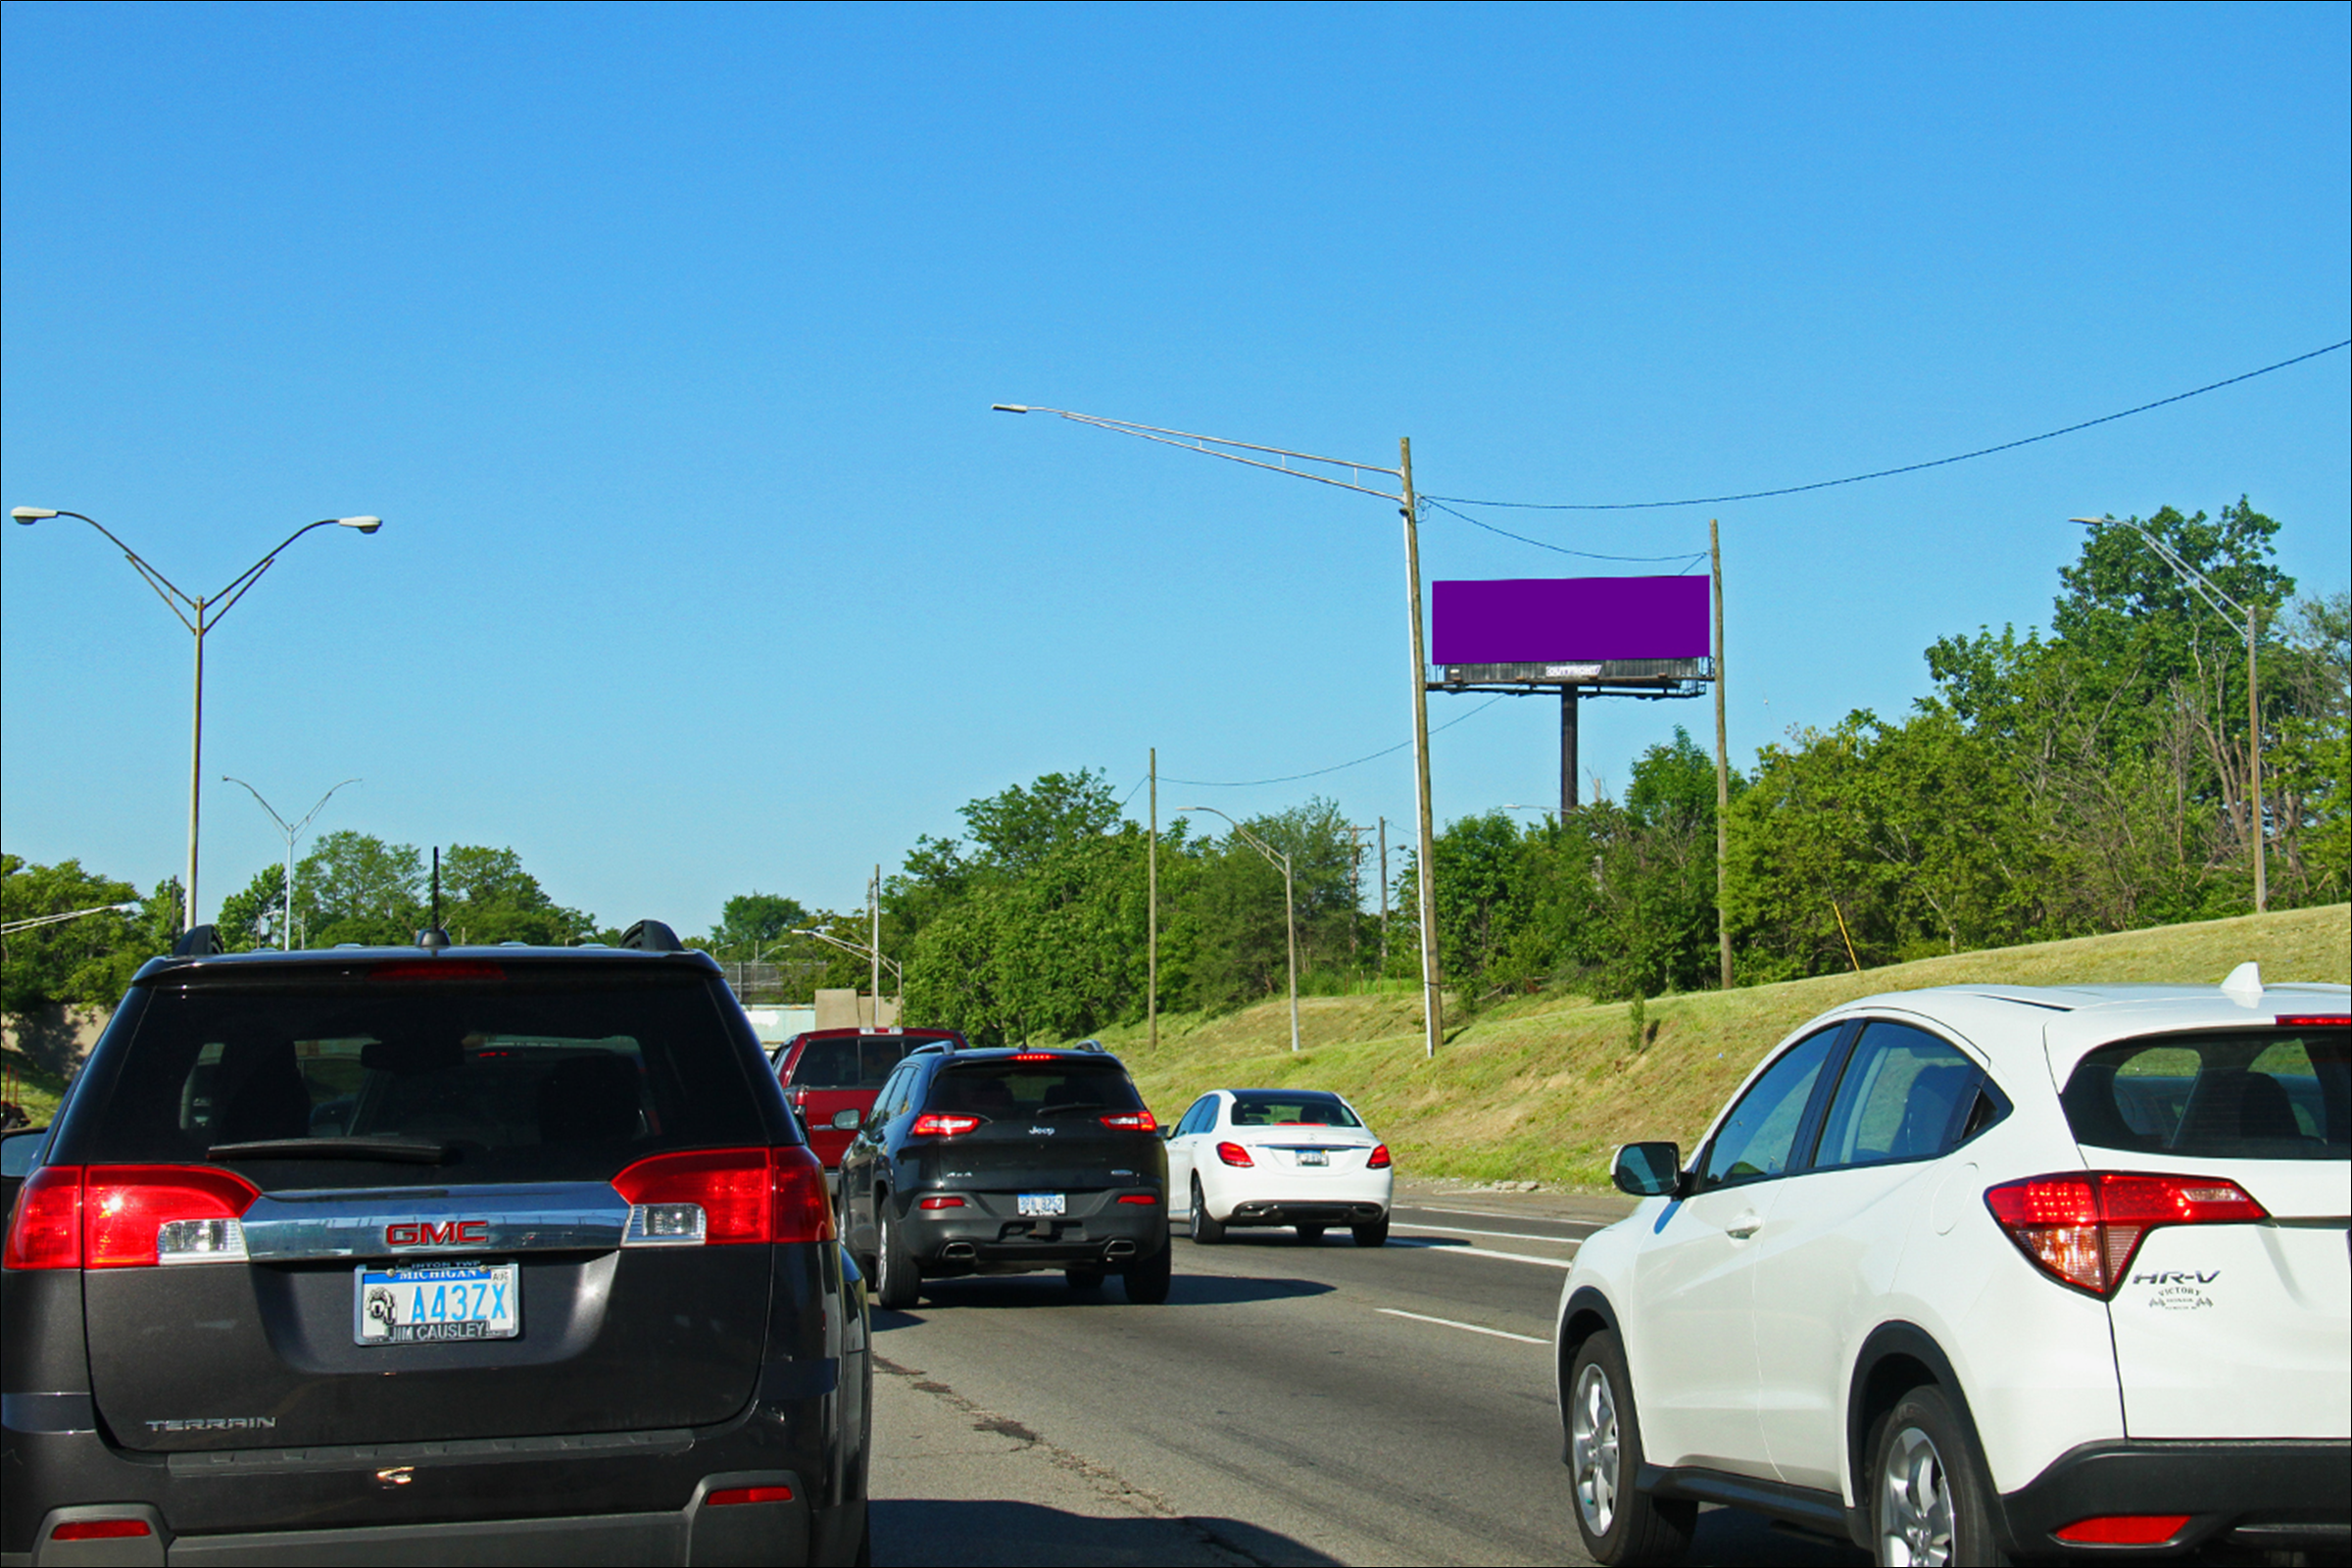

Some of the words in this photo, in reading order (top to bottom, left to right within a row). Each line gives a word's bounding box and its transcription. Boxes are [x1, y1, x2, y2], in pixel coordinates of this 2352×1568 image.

[1029, 1126, 1055, 1136] Jeep
[386, 1220, 488, 1246] GMC
[400, 1269, 477, 1280] MICHIGAN
[2132, 1270, 2221, 1285] HR-V
[2158, 1286, 2201, 1297] VICTORY
[411, 1283, 508, 1324] A43ZX
[389, 1324, 414, 1342] JIM
[416, 1321, 485, 1341] CAUSLEY
[146, 1417, 276, 1433] TERRAIN
